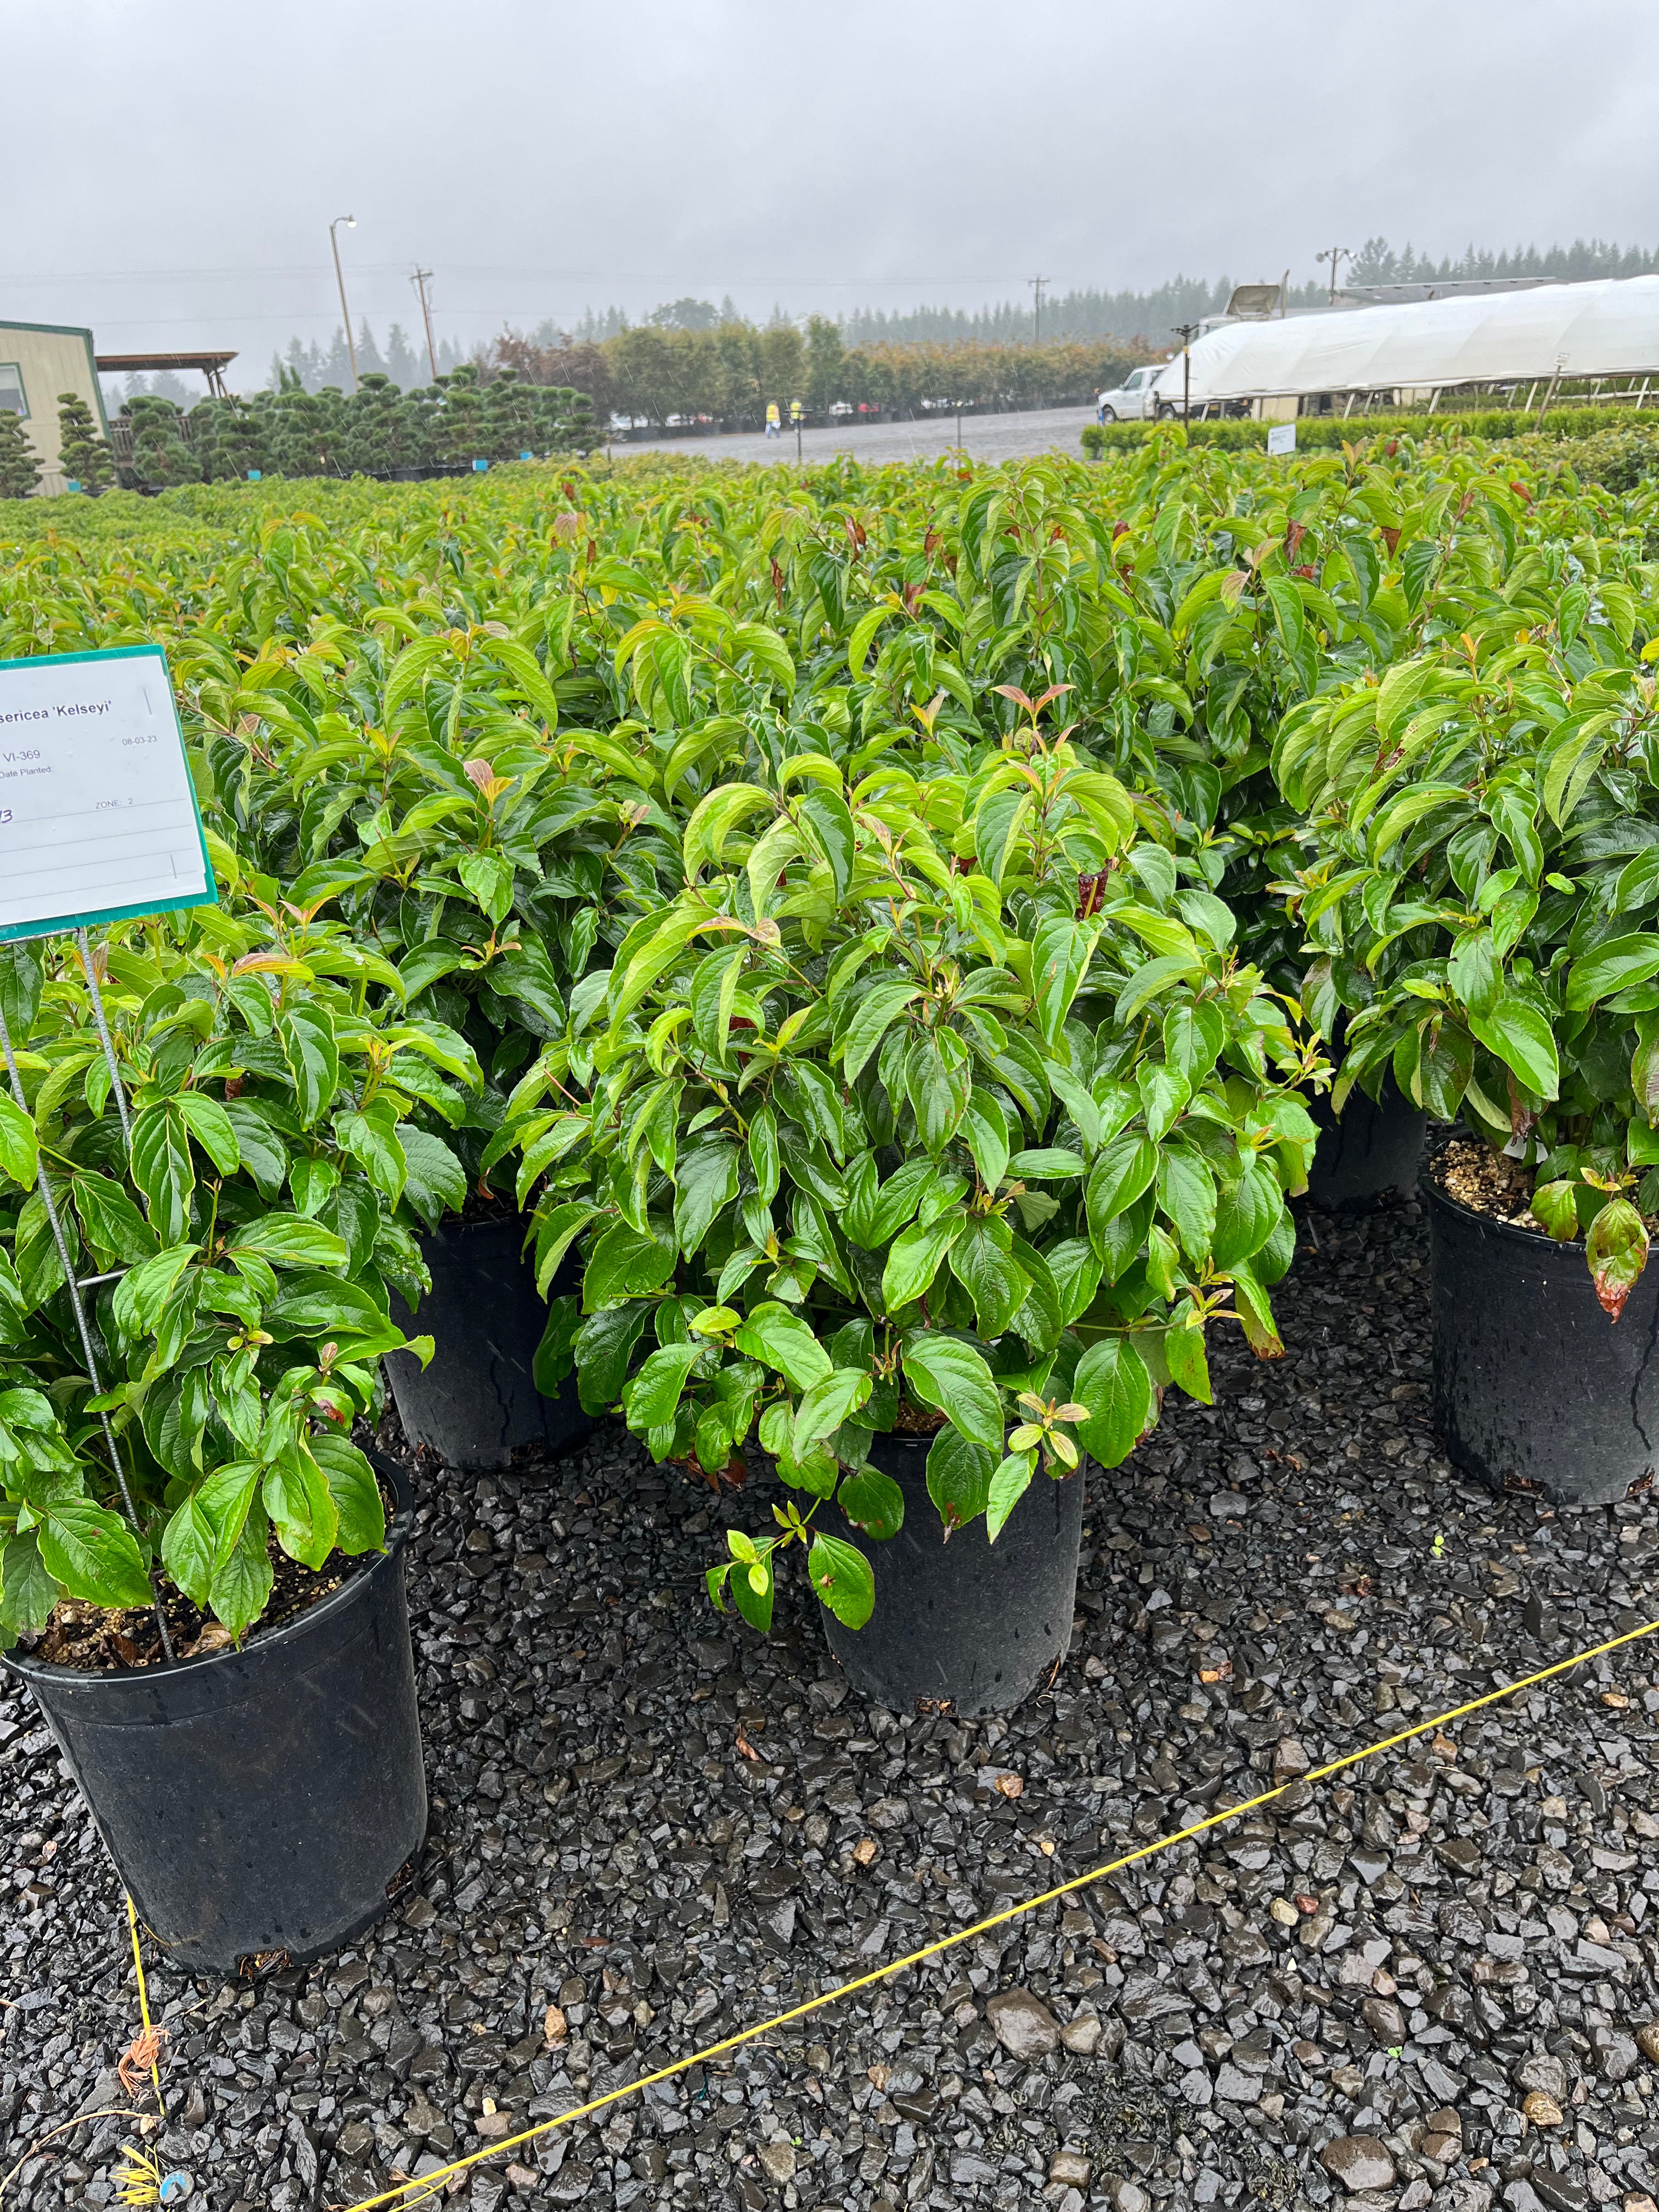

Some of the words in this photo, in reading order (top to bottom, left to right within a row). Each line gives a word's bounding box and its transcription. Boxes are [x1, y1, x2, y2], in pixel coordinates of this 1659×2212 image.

[0, 710, 49, 723] sericea
[53, 700, 111, 716] 'Kelseyi'
[122, 735, 157, 746] 08-03-23
[3, 749, 41, 762] VI-369
[20, 766, 54, 776] Planted:
[95, 799, 122, 809] ZONE:
